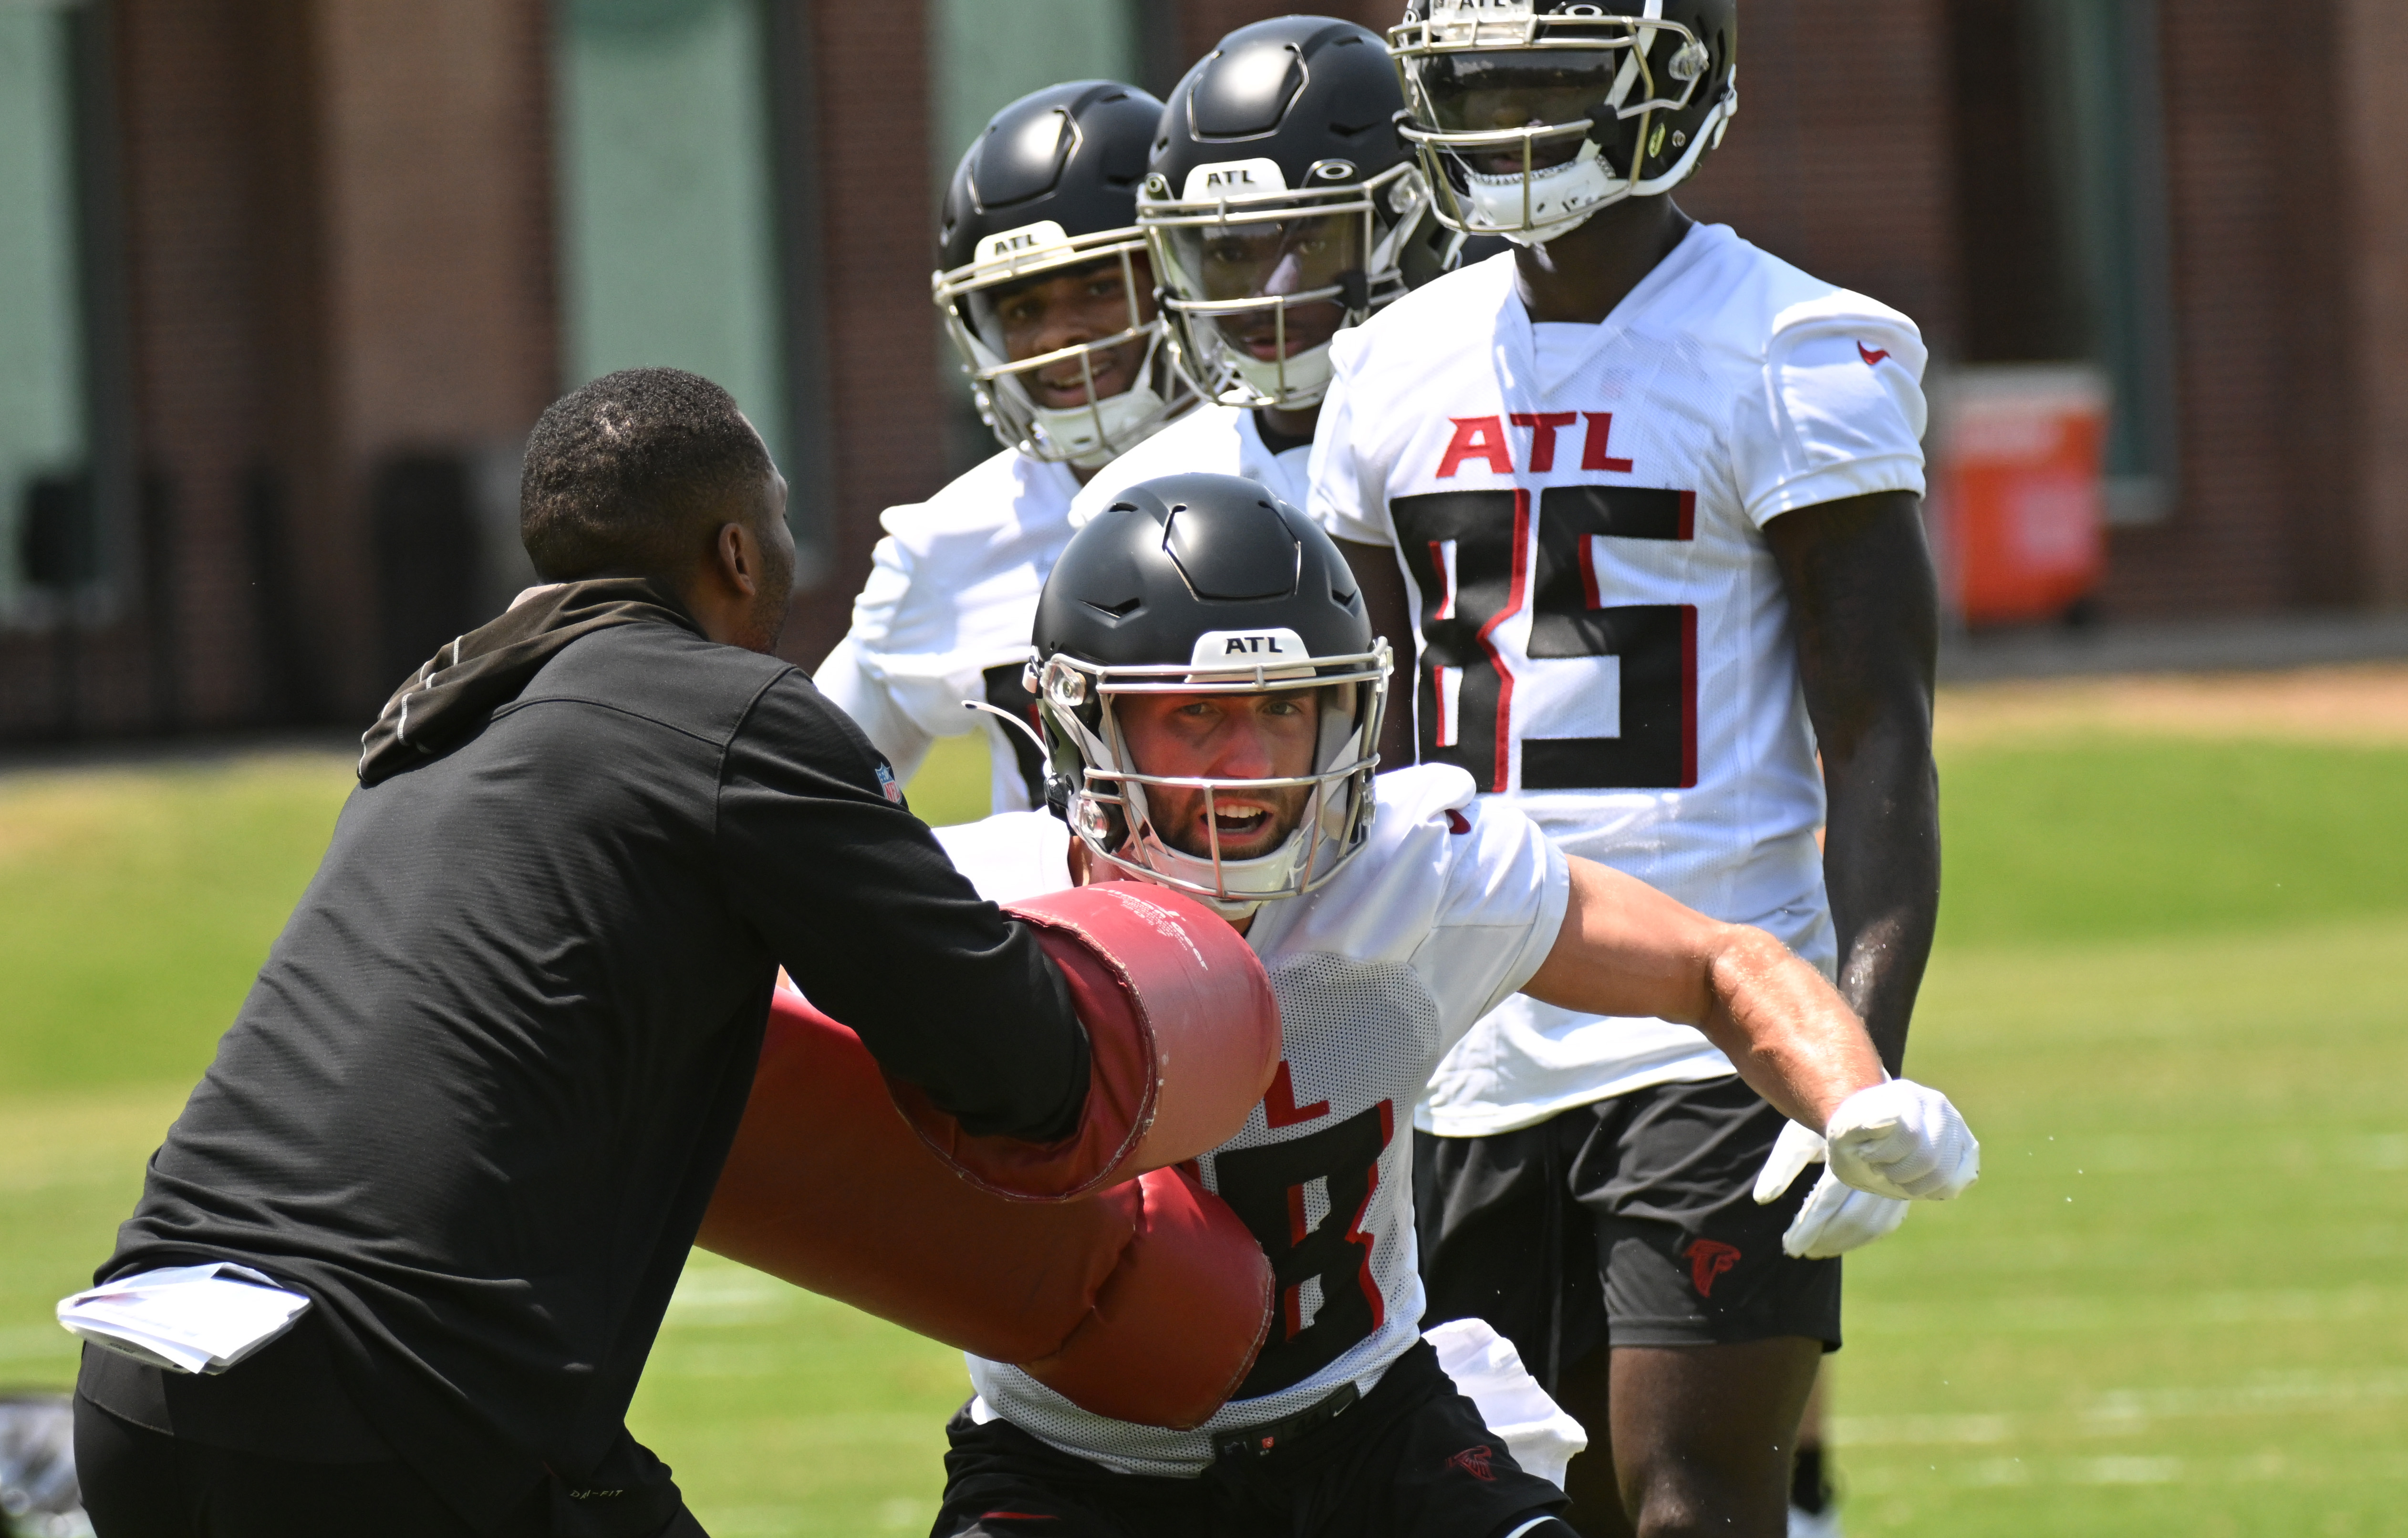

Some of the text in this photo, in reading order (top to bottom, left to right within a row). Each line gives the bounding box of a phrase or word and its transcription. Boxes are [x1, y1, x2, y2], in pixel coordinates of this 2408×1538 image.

[1208, 170, 1254, 187] ATL
[995, 234, 1040, 256] ATL
[1436, 411, 1633, 479] ATL
[1225, 637, 1283, 654] ATL
[1390, 485, 1697, 792] 85
[1170, 921, 1208, 970] Gear
